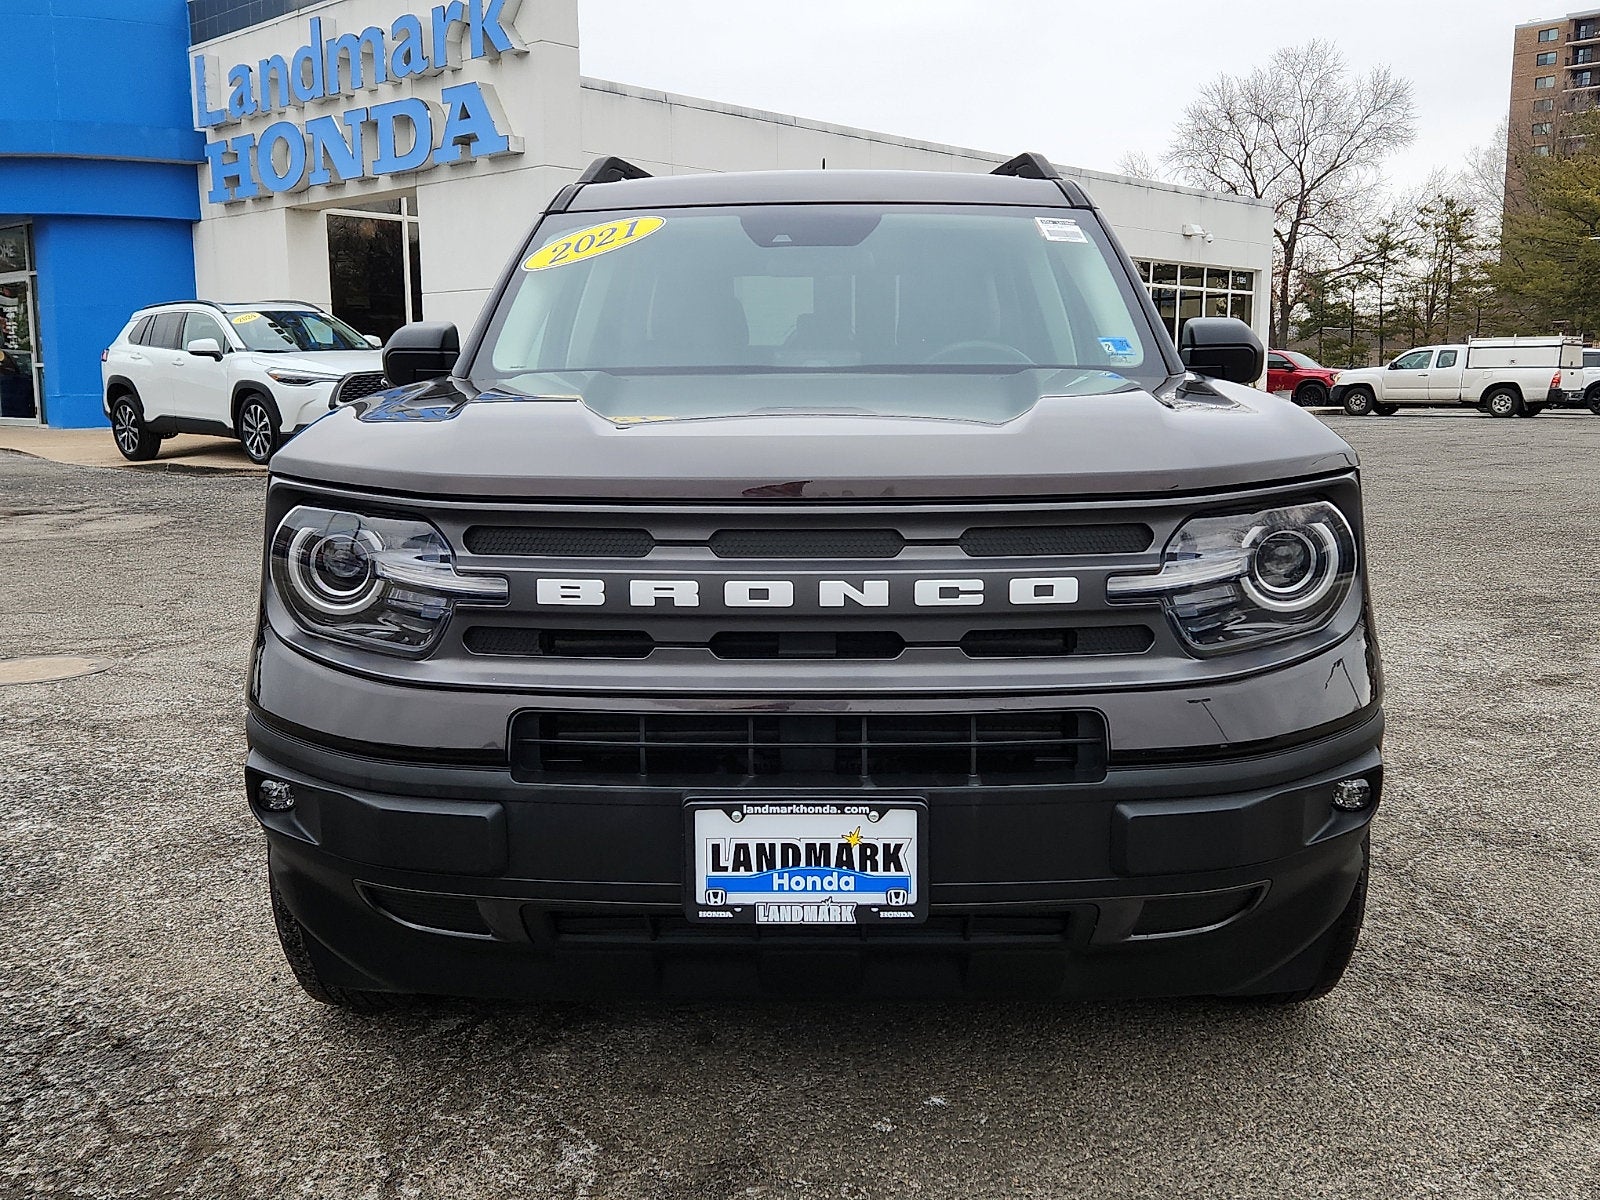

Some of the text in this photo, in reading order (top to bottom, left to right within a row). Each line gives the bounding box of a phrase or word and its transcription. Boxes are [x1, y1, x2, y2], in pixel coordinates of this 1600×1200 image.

[194, 0, 513, 129] Landmark
[204, 81, 510, 204] HONDA
[548, 220, 639, 265] 2021
[536, 577, 1079, 607] BRONCO
[711, 842, 905, 873] LANDMARK
[773, 872, 855, 891] Honda
[698, 910, 734, 918] HONDA
[757, 903, 855, 923] LANDMARK
[879, 910, 915, 918] HONDA
